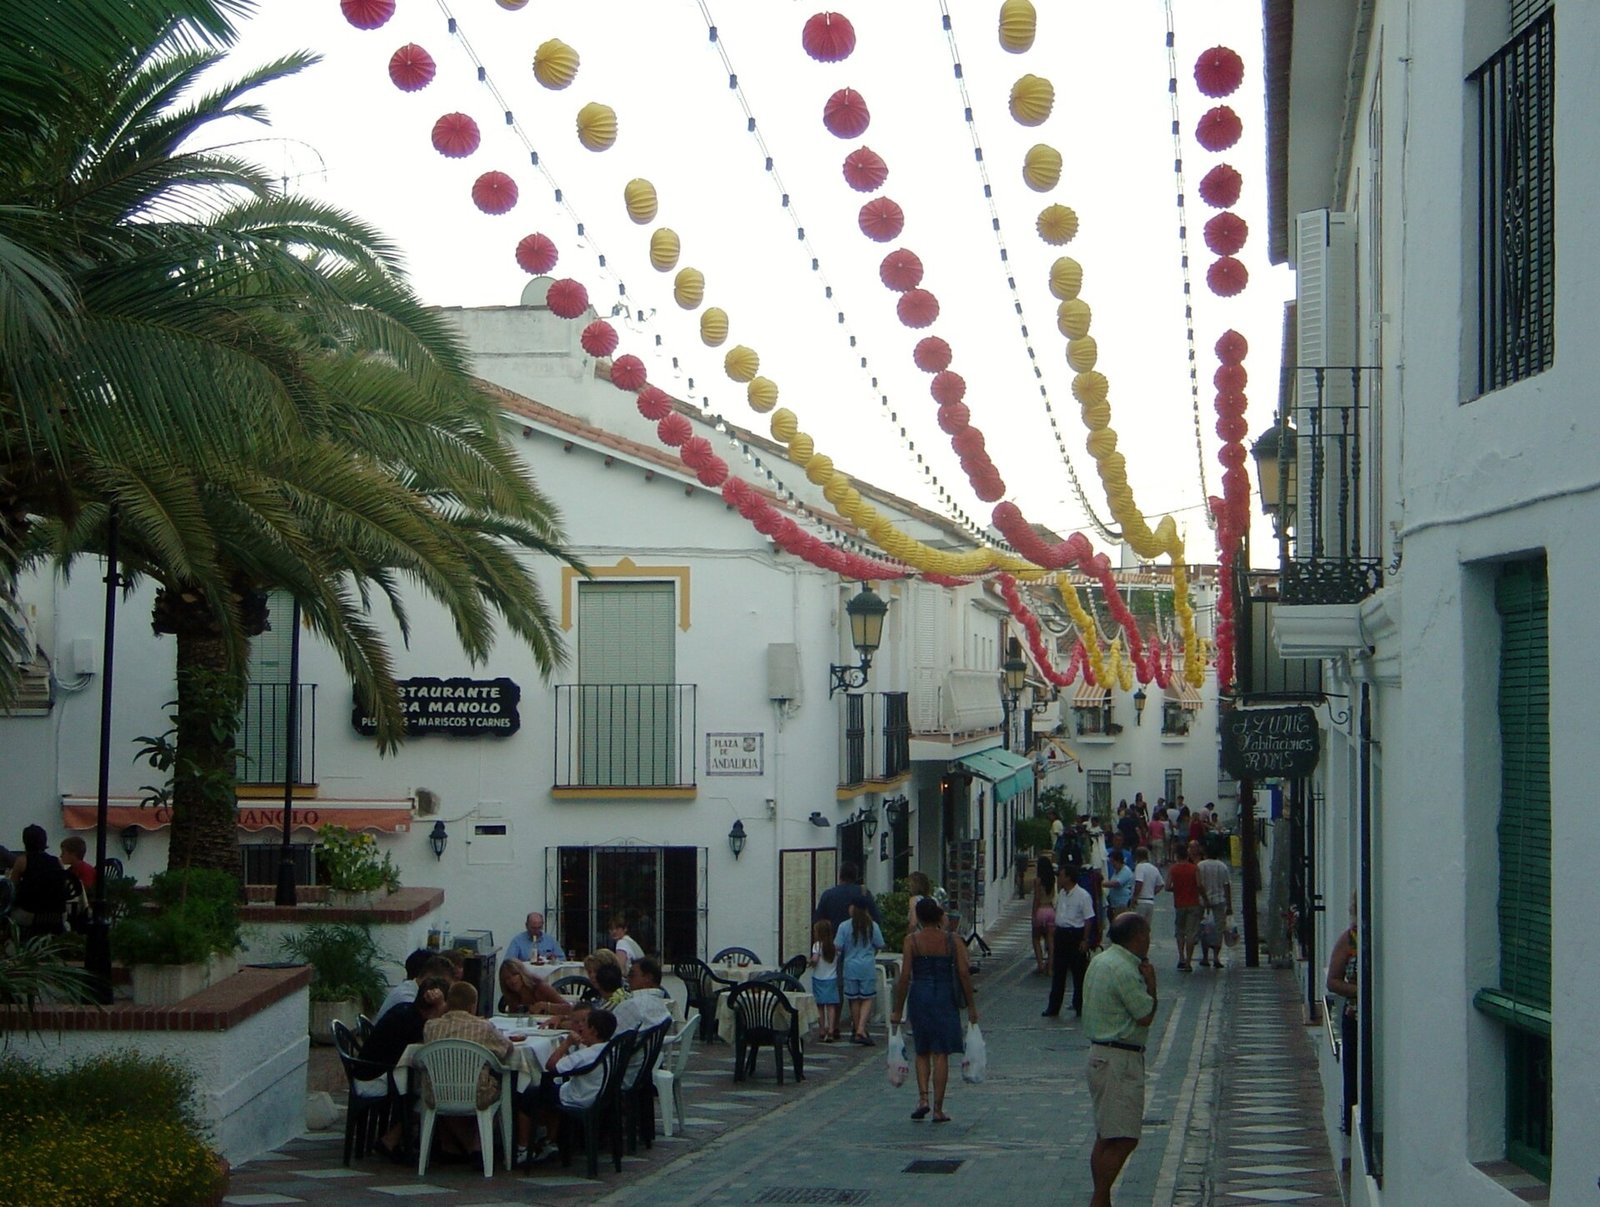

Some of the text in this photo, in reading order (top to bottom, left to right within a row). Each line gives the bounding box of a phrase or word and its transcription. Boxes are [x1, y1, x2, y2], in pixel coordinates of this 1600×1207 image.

[398, 686, 502, 699] STAURANTE
[428, 702, 501, 714] MANOLO
[418, 716, 467, 727] MARISCOS
[469, 717, 476, 727] Y
[476, 717, 511, 728] CARNES
[714, 739, 738, 748] PLAZA
